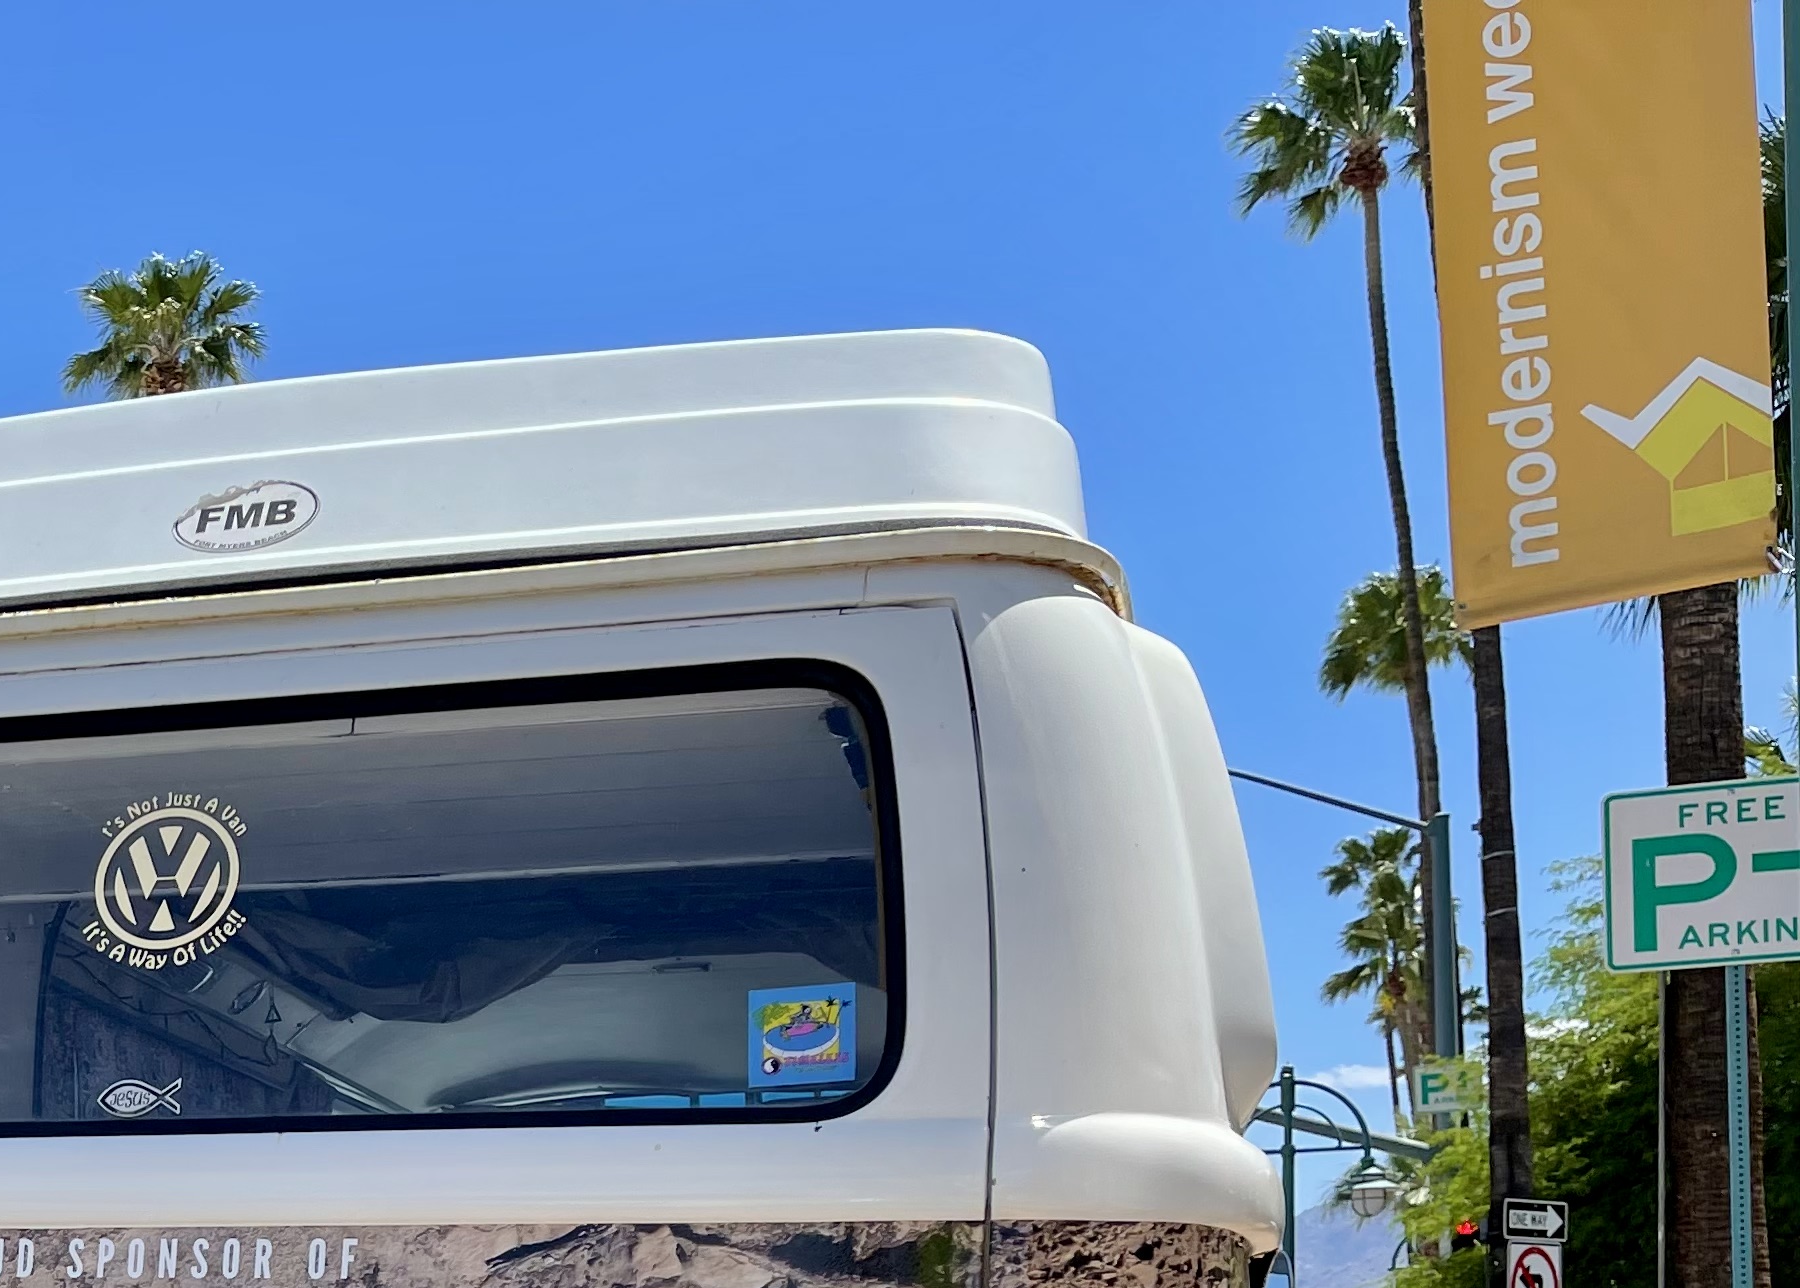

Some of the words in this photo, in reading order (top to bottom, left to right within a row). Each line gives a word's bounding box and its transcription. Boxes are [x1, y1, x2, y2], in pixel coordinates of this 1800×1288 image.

[1482, 0, 1534, 124] we
[1480, 138, 1560, 568] modernism
[195, 499, 297, 533] FMB
[126, 795, 158, 819] Not
[165, 791, 201, 808] Just
[204, 797, 218, 813] A
[221, 805, 248, 837] Van
[1679, 795, 1786, 828] FREE
[82, 920, 109, 952] It's
[108, 944, 125, 963] A
[128, 948, 167, 970] Way
[173, 942, 197, 966] Of
[200, 909, 247, 954] Life!!
[1678, 917, 1798, 949] ARKIN
[66, 1237, 272, 1280] SPONSOR
[306, 1237, 359, 1280] OF
